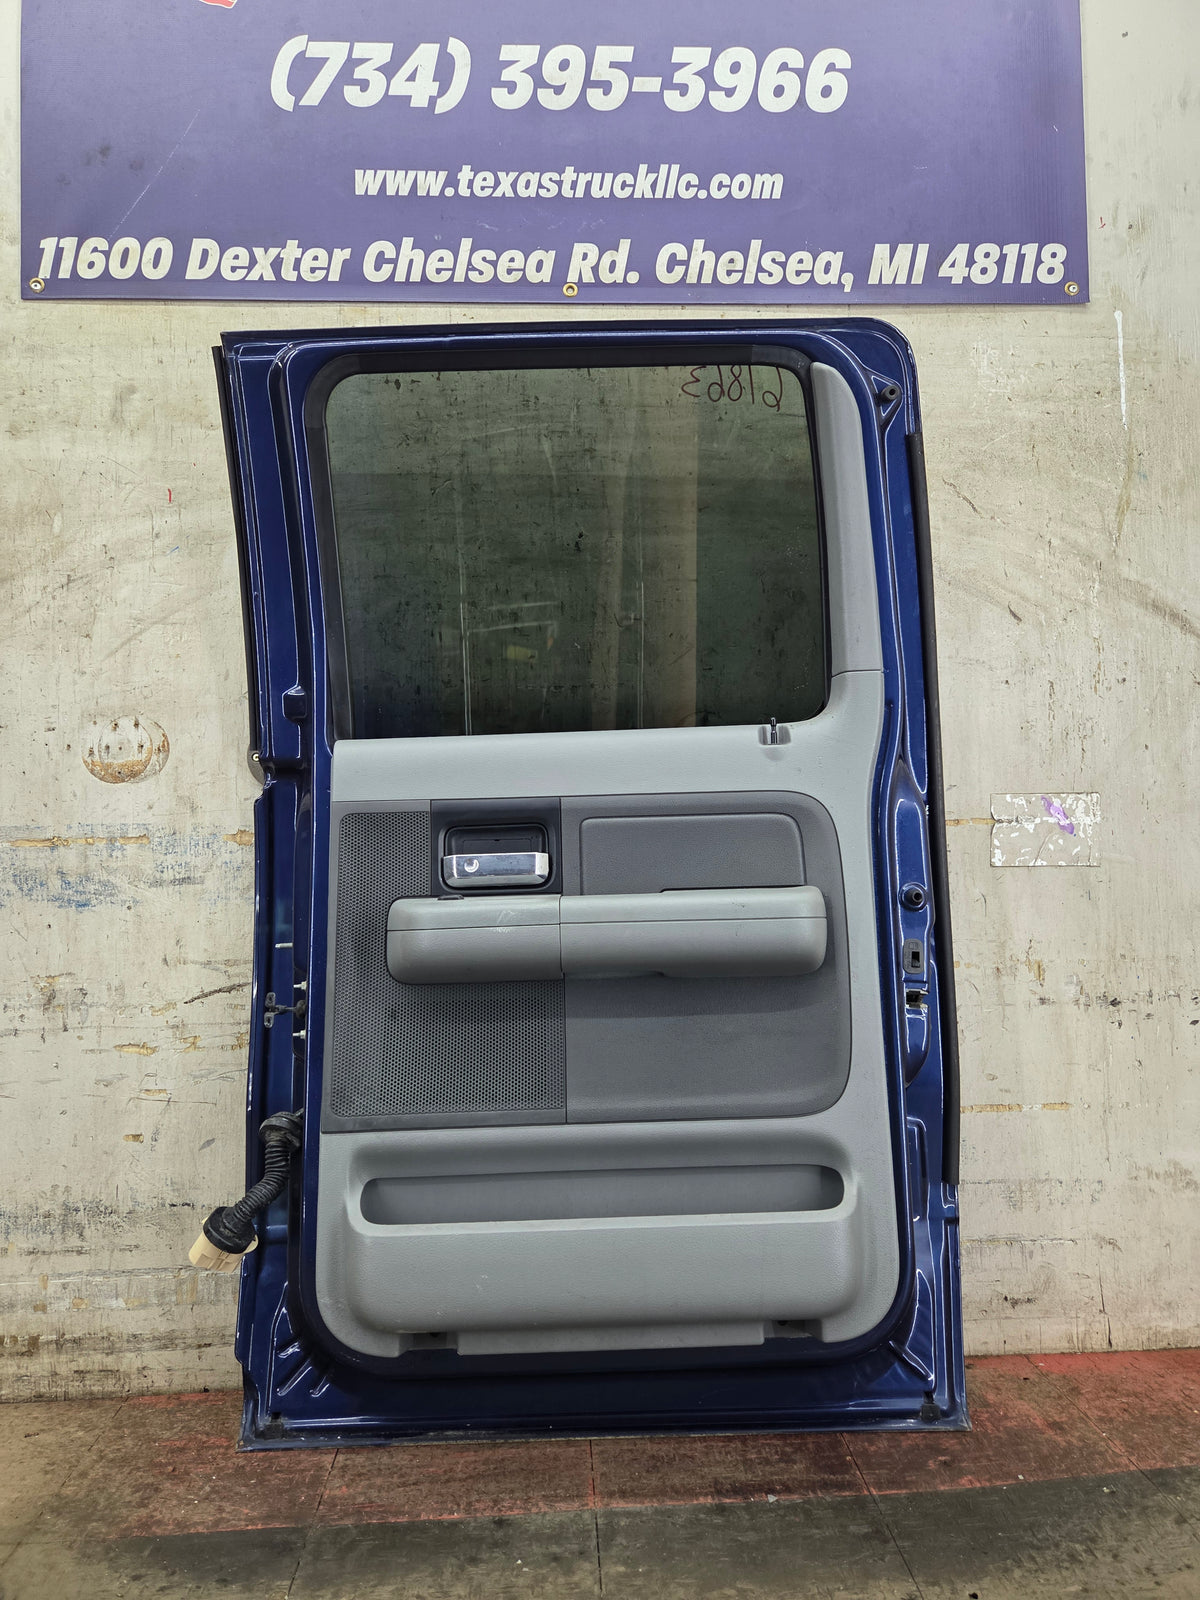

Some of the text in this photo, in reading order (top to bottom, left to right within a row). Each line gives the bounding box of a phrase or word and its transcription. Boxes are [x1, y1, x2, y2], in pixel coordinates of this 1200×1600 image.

[270, 34, 852, 115] (734) 395-3966
[354, 164, 784, 200] www.texastruckllc.com
[38, 237, 1067, 293] 11600 Dexter Chelsea Rd. Chelsea, MI 48118
